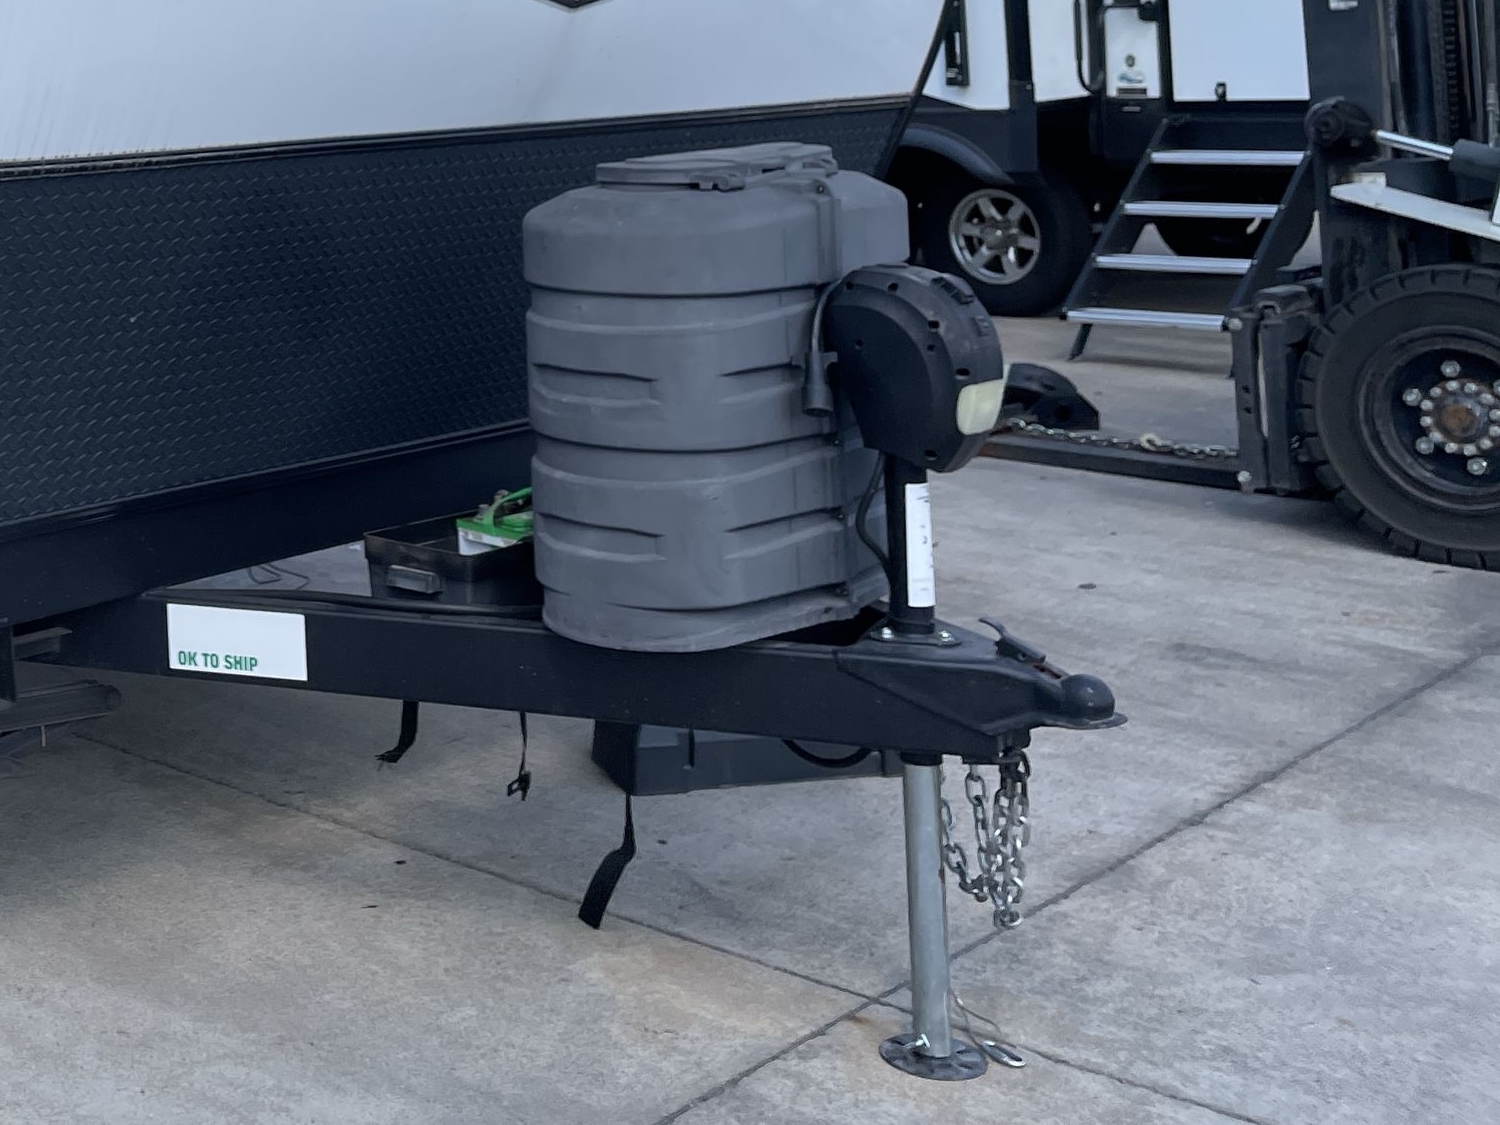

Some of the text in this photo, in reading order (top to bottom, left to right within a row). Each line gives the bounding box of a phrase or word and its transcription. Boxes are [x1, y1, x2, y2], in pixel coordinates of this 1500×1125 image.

[178, 650, 258, 671] OK TO SHIP
